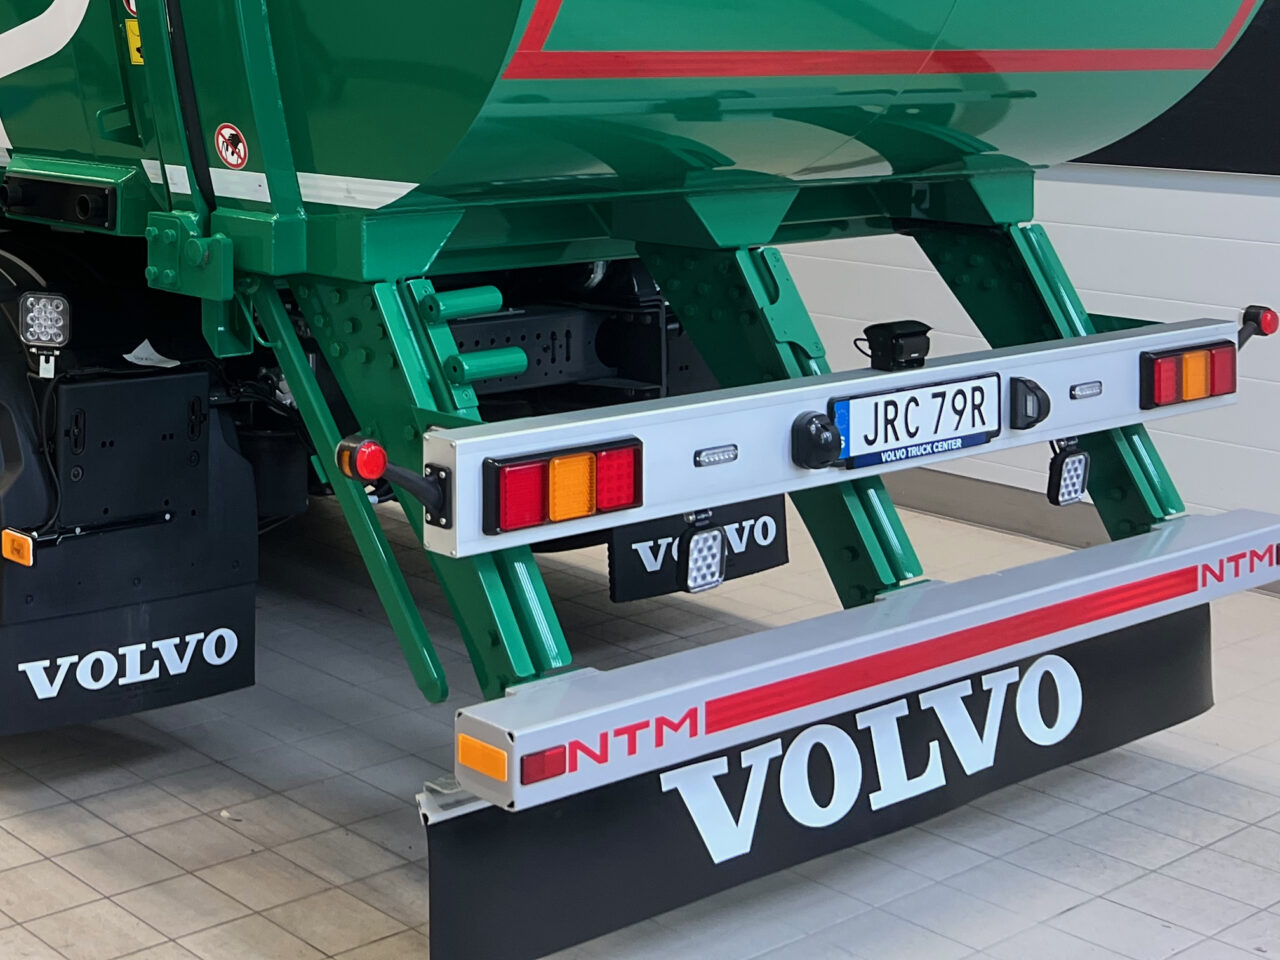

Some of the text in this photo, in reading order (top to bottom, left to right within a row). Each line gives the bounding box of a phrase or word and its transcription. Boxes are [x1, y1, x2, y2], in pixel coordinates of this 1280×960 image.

[863, 385, 986, 446] JRC 79R
[880, 438, 963, 463] VOLVO TRUCK CENTER
[631, 515, 777, 572] VVO
[1201, 544, 1274, 588] NTM
[17, 627, 239, 700] VOLVO
[568, 706, 699, 773] NTM
[659, 653, 1083, 865] VOLVO
